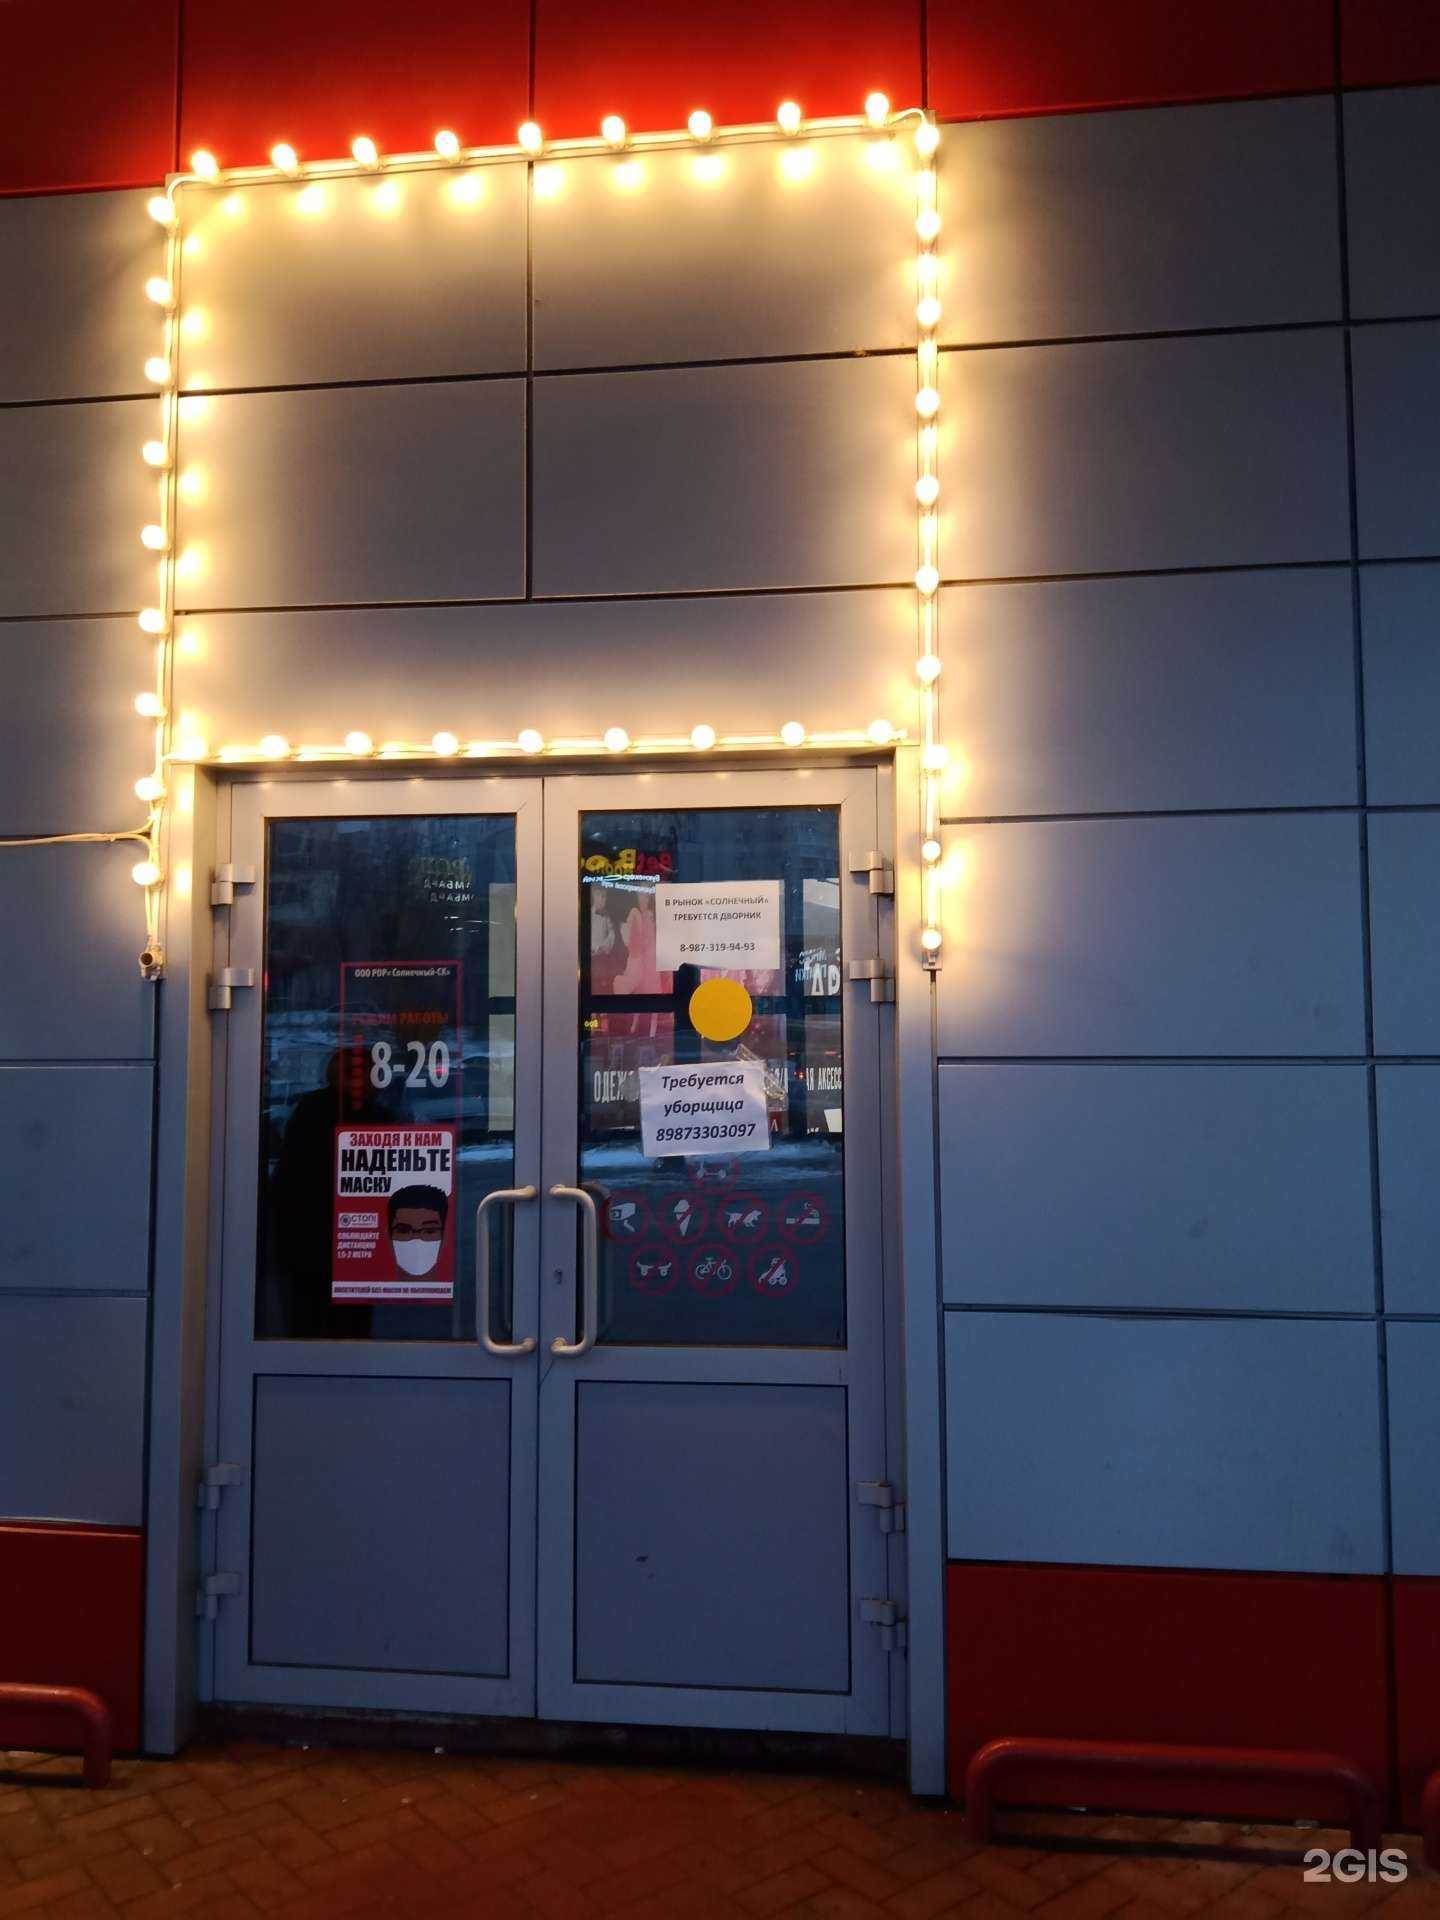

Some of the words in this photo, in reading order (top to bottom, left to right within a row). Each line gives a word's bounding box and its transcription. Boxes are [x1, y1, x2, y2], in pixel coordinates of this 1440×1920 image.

[665, 898, 671, 907] В
[672, 898, 704, 906] РЫНОК
[673, 912, 720, 921] ТРЕБУЕТСЯ
[720, 911, 762, 921] ДВОРНИК
[679, 942, 756, 953] 8-987-319-94-93
[354, 968, 372, 978] ООО
[370, 1040, 450, 1089] 8-20
[662, 1073, 745, 1091] Требуется
[664, 1099, 744, 1117] уборщица
[350, 1132, 401, 1149] ЗАХОДЯ
[403, 1133, 413, 1147] К
[414, 1133, 442, 1147] НАМ
[656, 1123, 757, 1142] 89873303097
[341, 1148, 451, 1175] НАДЕНЬТЕ
[339, 1176, 392, 1194] МАСКУ
